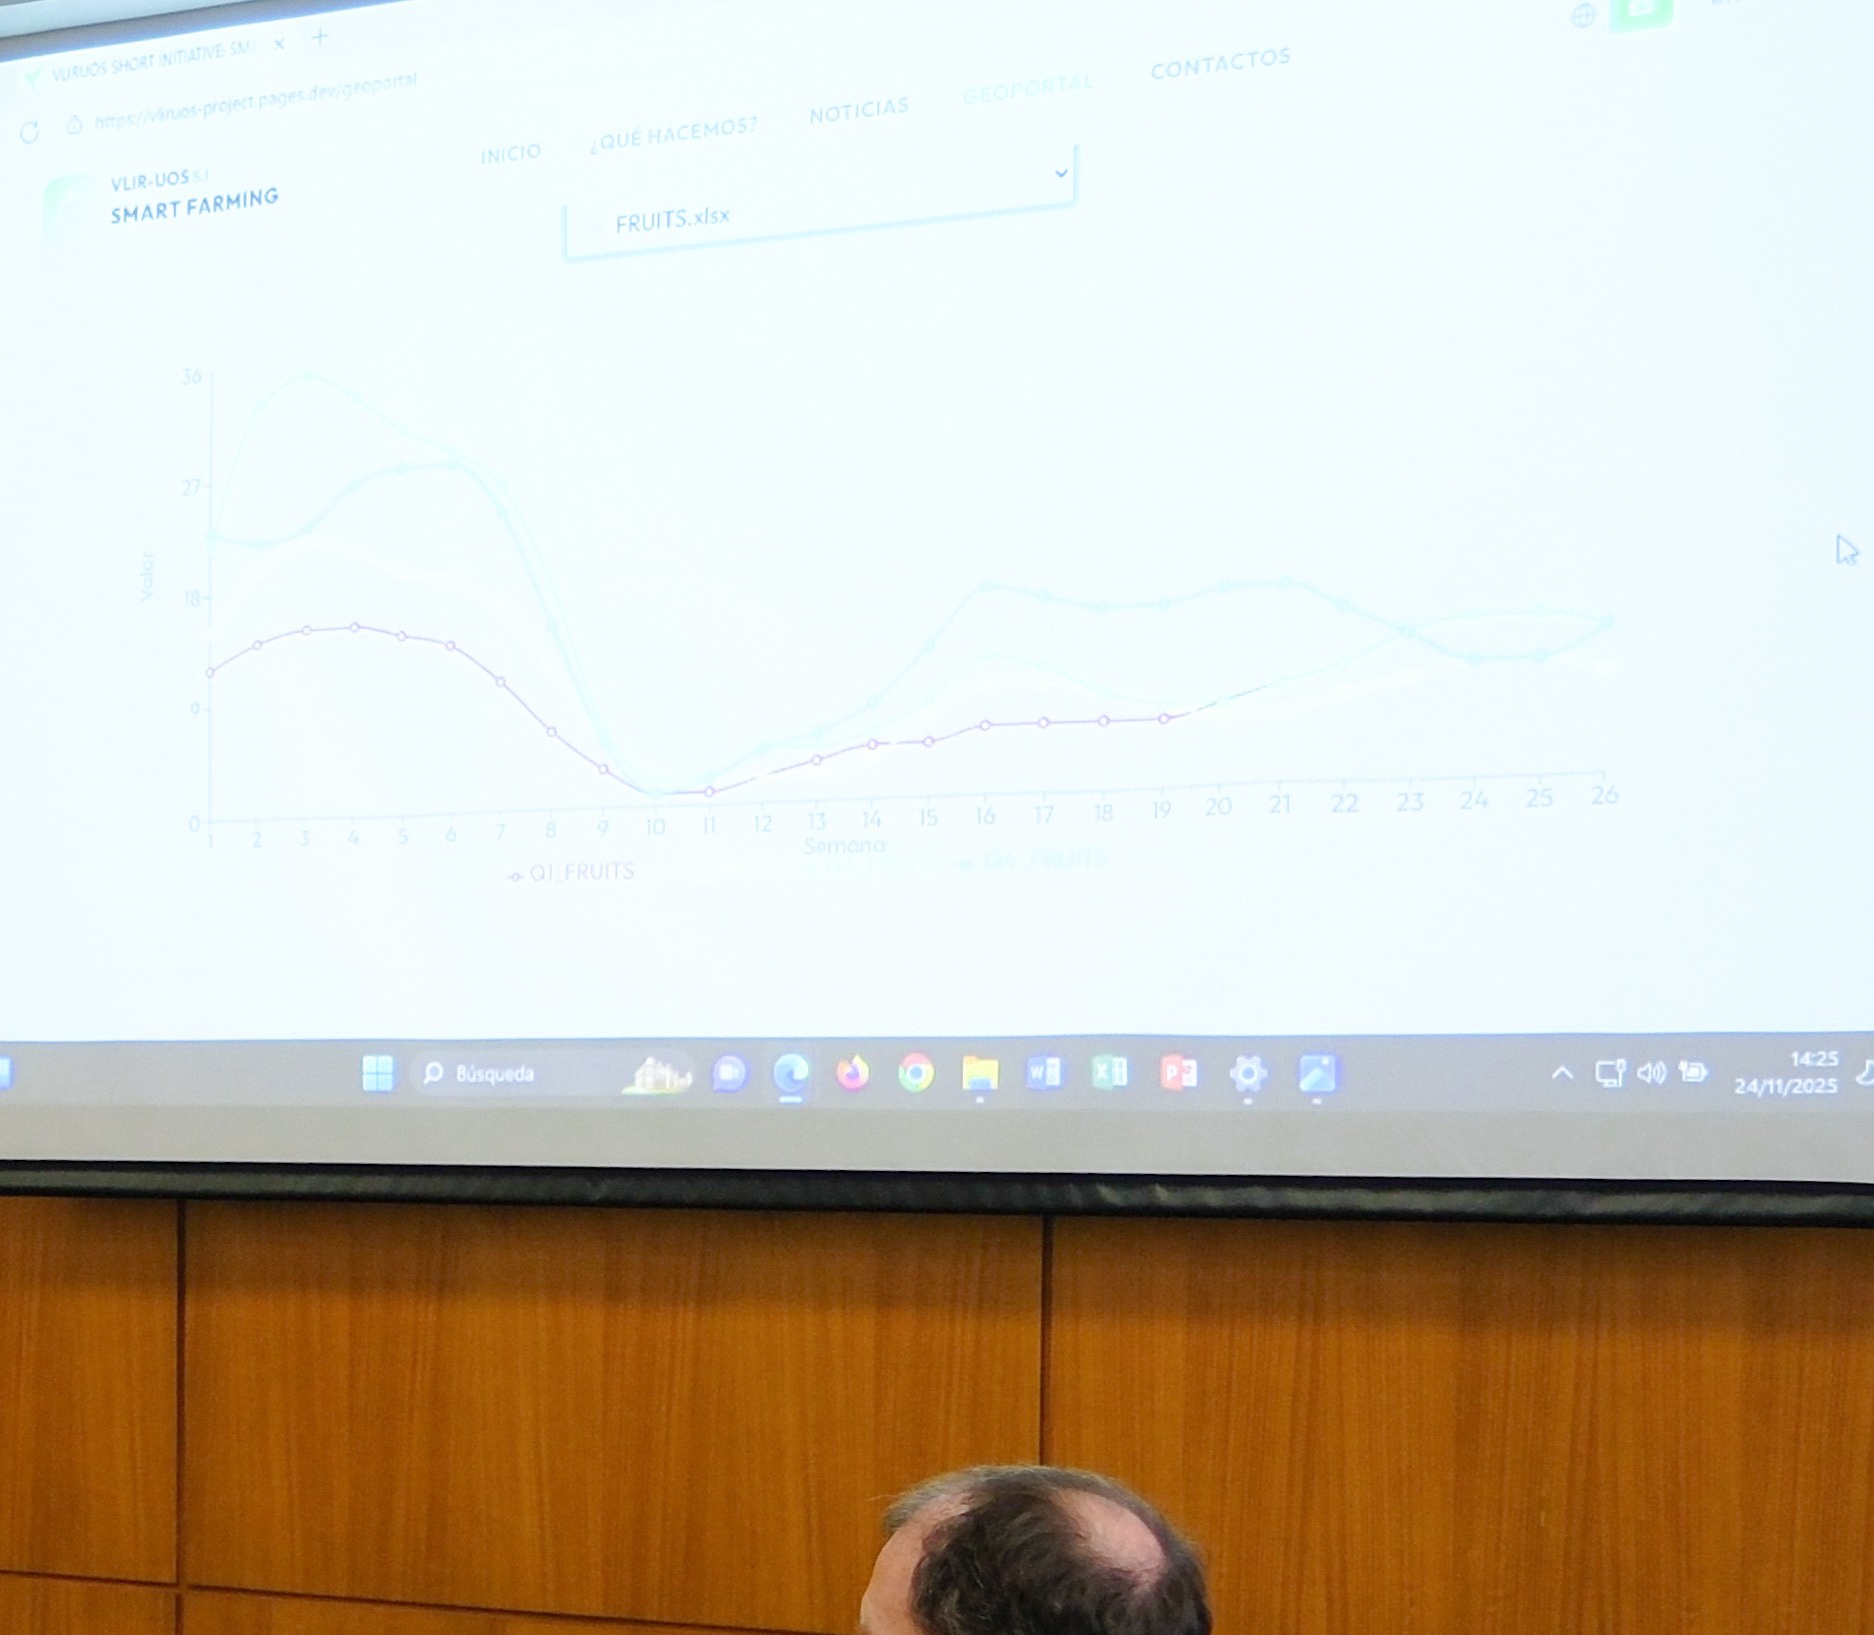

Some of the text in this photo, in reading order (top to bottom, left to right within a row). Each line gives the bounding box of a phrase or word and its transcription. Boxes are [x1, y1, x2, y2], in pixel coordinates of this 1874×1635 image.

[1150, 45, 1292, 82] CONTACTOS
[962, 71, 1097, 106] GEOPORTAL
[808, 97, 910, 126] NOTICIAS
[589, 114, 759, 157] ¿QUÉ HACEMOS?
[480, 142, 542, 166] INICIO
[111, 168, 190, 193] VLIR-UOS
[110, 187, 281, 226] SMART FARMING
[615, 206, 731, 236] FRUITS.xlsx
[181, 367, 202, 386] 36
[180, 478, 201, 497] 27
[139, 551, 155, 603] Valor
[183, 590, 201, 607] 18
[190, 701, 201, 719] 9
[1269, 794, 1292, 814] 21
[1331, 793, 1359, 814] 22
[1395, 792, 1424, 813] 23
[1459, 790, 1488, 811] 24
[1524, 787, 1553, 808] 25
[1591, 784, 1619, 805] 26
[976, 805, 996, 825] 16
[1035, 804, 1055, 824] 17
[1094, 803, 1114, 823] 18
[1152, 800, 1172, 820] 19
[1204, 796, 1233, 817] 20
[188, 816, 202, 833] 0
[646, 819, 666, 836] 10
[702, 815, 716, 834] 11
[754, 813, 773, 833] 12
[808, 812, 828, 832] 13
[862, 809, 882, 828] 14
[919, 808, 938, 827] 15
[348, 829, 360, 847] 4
[398, 828, 409, 846] 5
[445, 825, 457, 844] 6
[496, 824, 507, 842] 7
[546, 822, 557, 840] 8
[598, 820, 609, 838] 9
[253, 831, 265, 850] 2
[300, 831, 310, 849] 3
[803, 836, 887, 855] Semana
[530, 860, 635, 885] Q1_FRUITS
[1791, 1050, 1840, 1067] 14:25
[456, 1063, 535, 1086] Búsqueda
